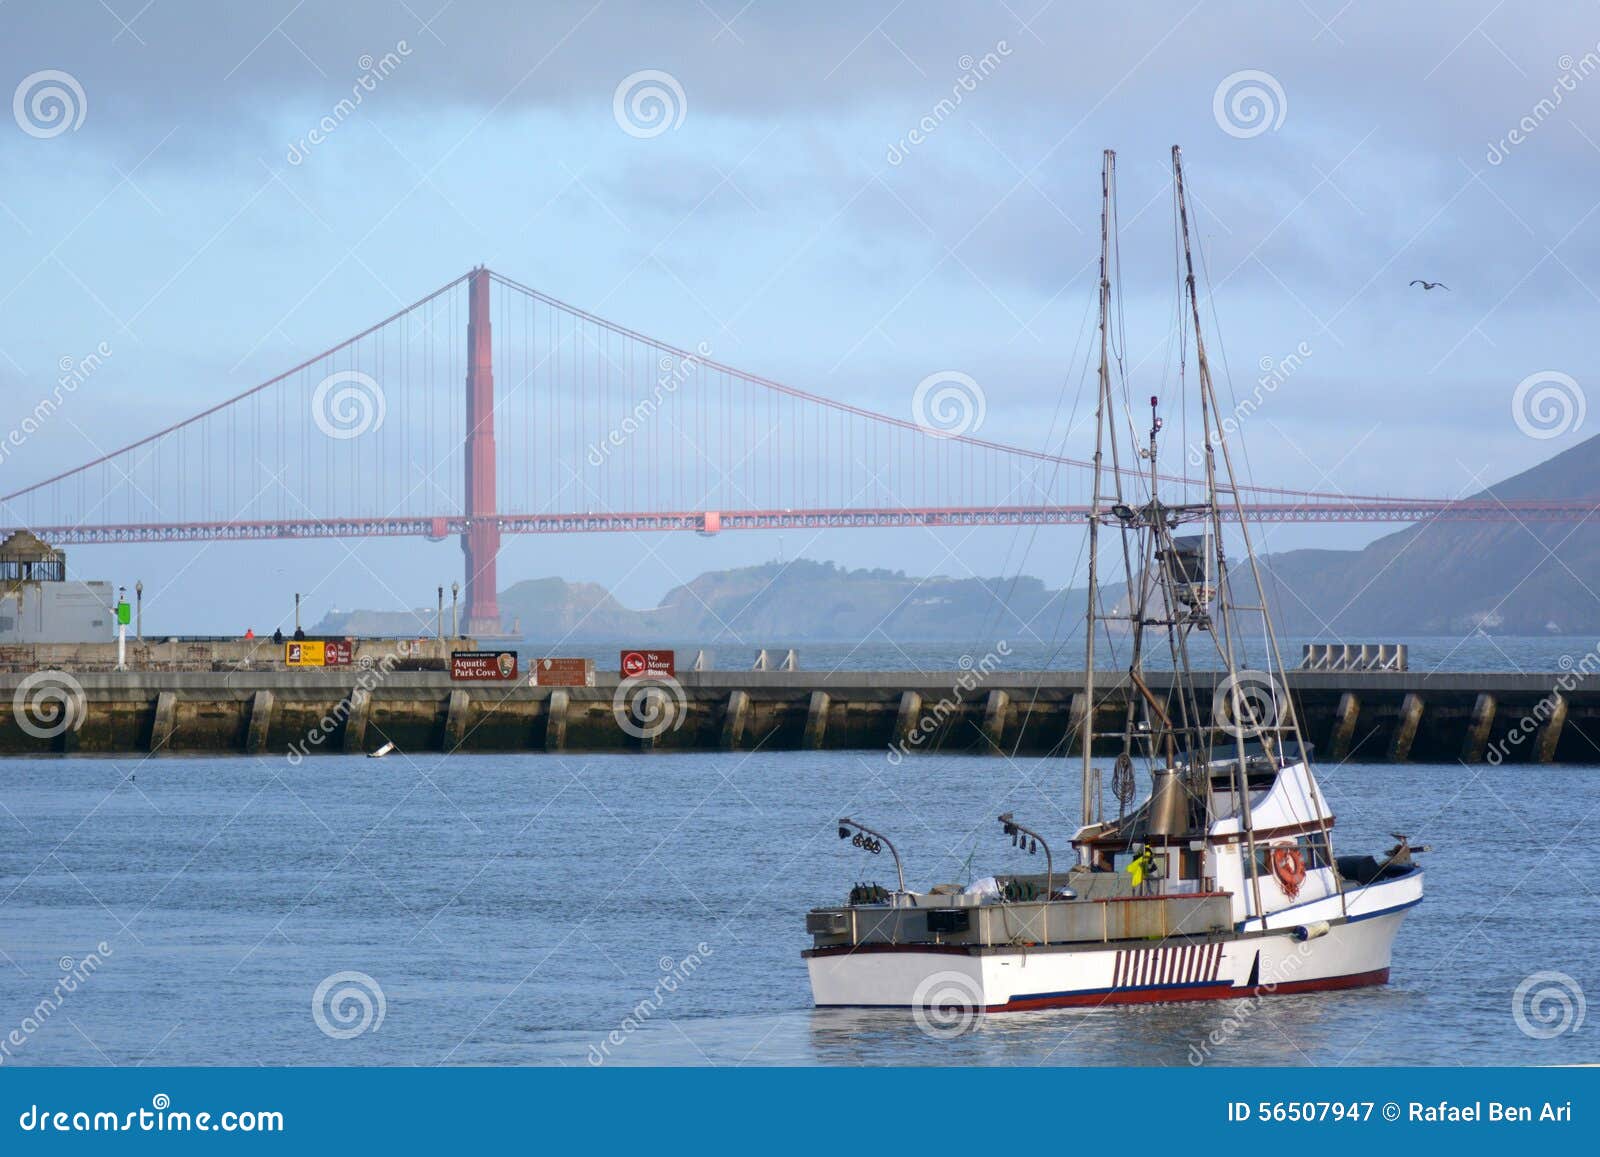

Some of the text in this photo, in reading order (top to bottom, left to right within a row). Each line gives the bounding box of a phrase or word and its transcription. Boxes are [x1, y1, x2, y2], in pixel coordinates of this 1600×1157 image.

[455, 660, 487, 670] Aquatic
[647, 661, 670, 669] Motor
[455, 669, 496, 677] Park Cove
